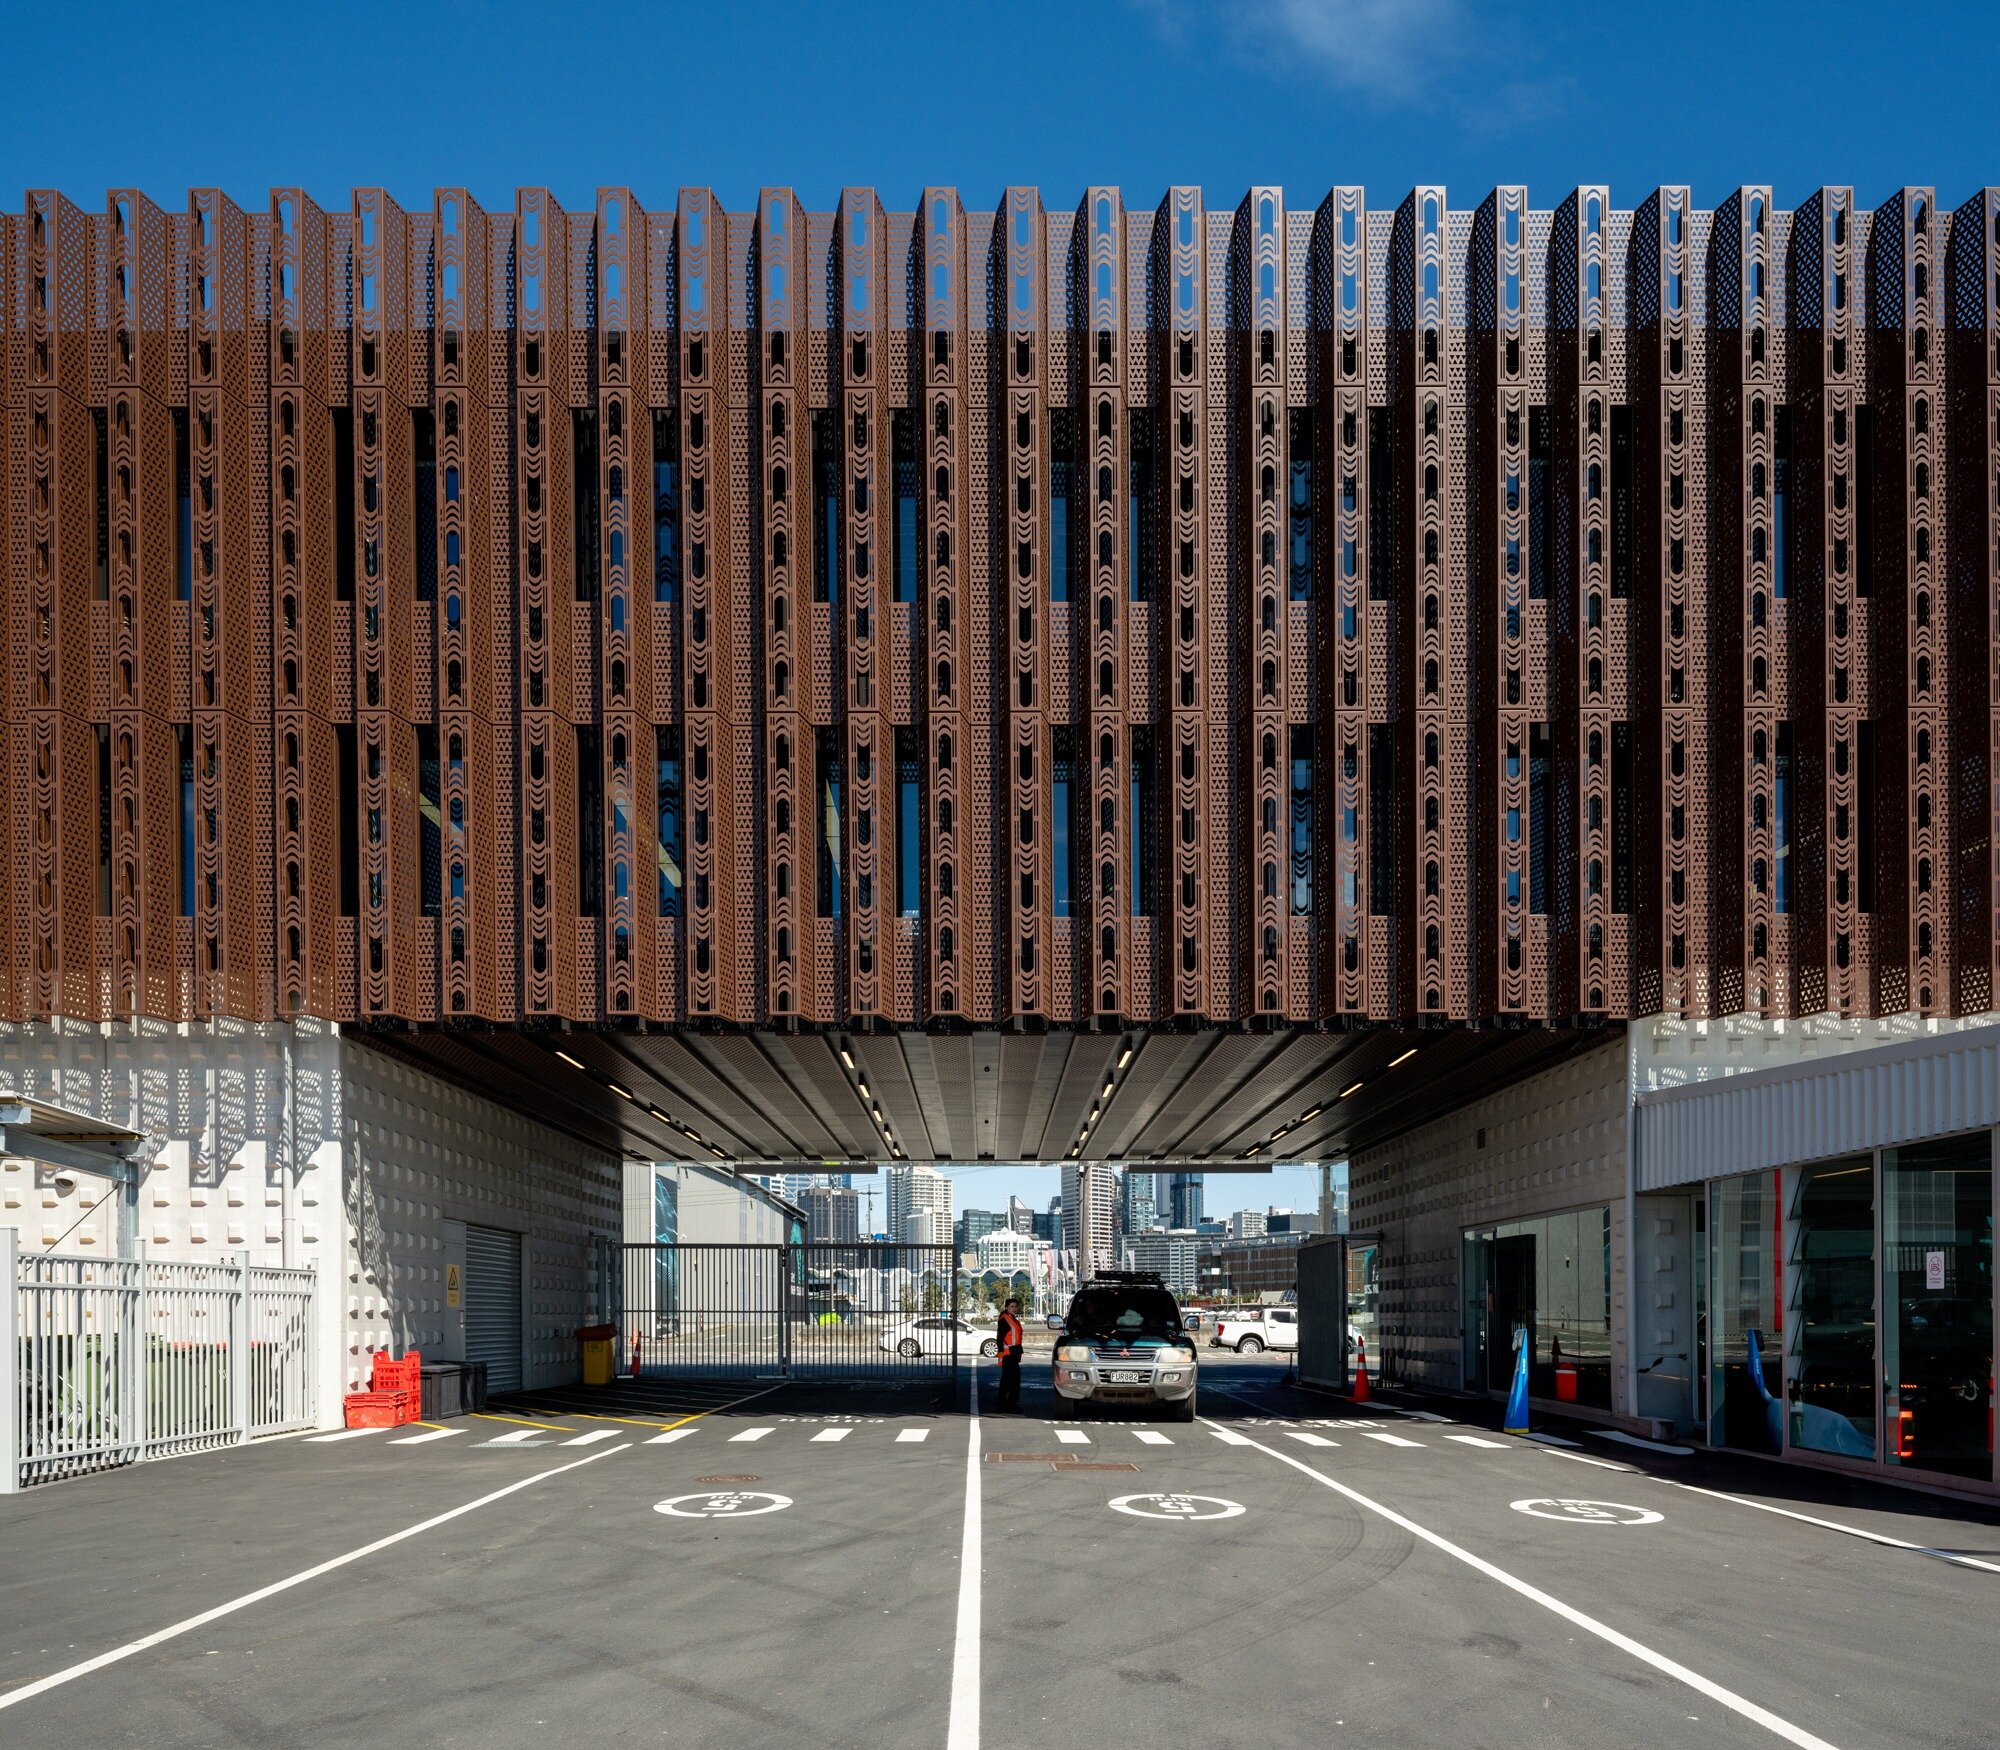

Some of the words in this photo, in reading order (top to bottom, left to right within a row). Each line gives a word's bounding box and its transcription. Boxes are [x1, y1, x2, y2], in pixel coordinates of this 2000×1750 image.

[701, 1499, 743, 1511] 5
[1158, 1501, 1197, 1512] 5
[1563, 1506, 1619, 1518] 5
